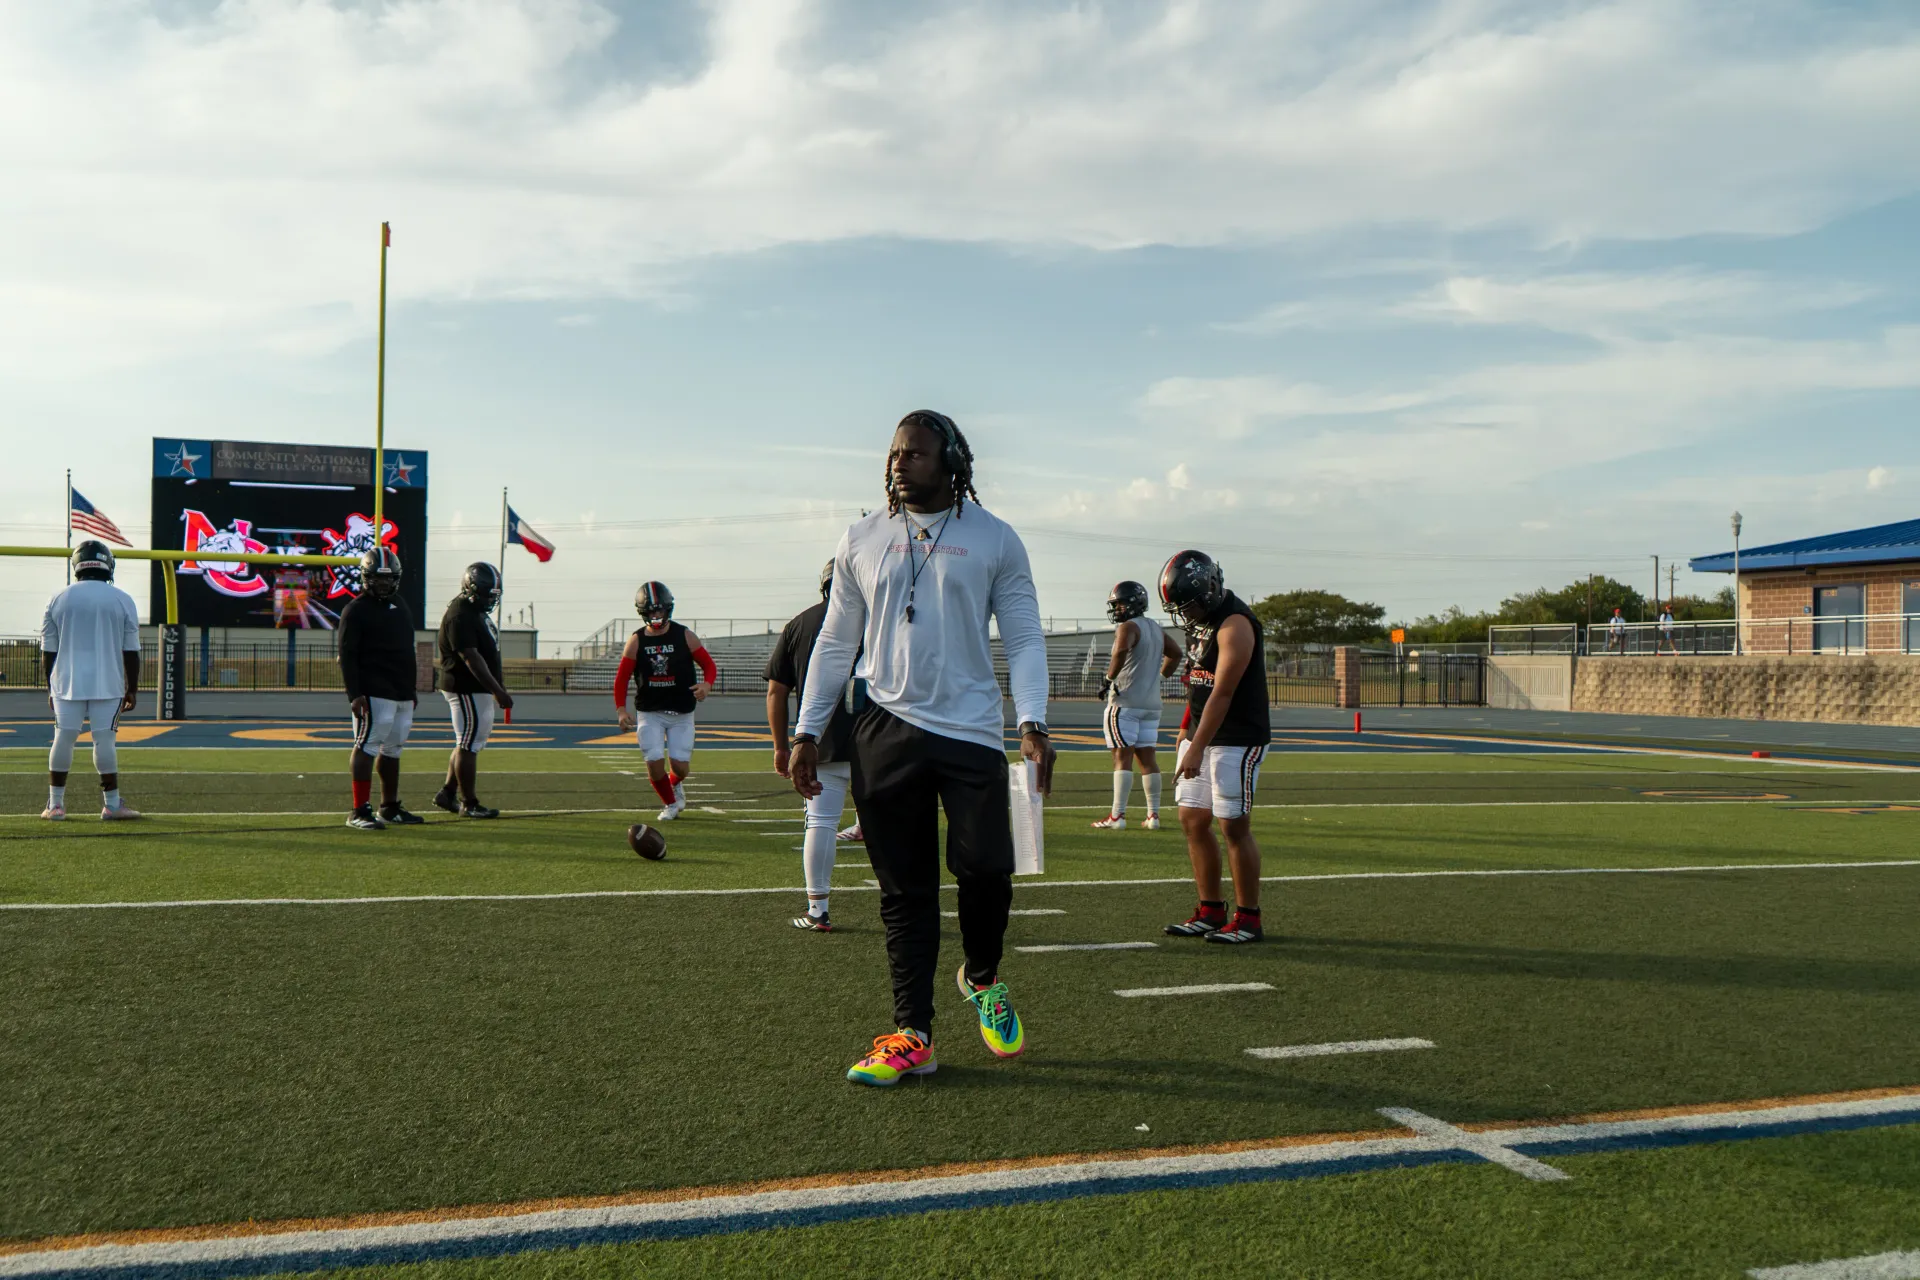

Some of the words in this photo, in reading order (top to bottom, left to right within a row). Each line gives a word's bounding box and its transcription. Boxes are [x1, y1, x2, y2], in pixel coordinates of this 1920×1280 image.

[216, 450, 299, 463] COMMUNITY
[303, 454, 368, 466] NATIONAL
[217, 460, 251, 469] BANK
[254, 461, 265, 470] &
[269, 462, 307, 471] TRUST
[331, 465, 369, 474] TEXAS
[644, 644, 675, 655] TEXAS
[165, 644, 175, 719] BULLDOGS
